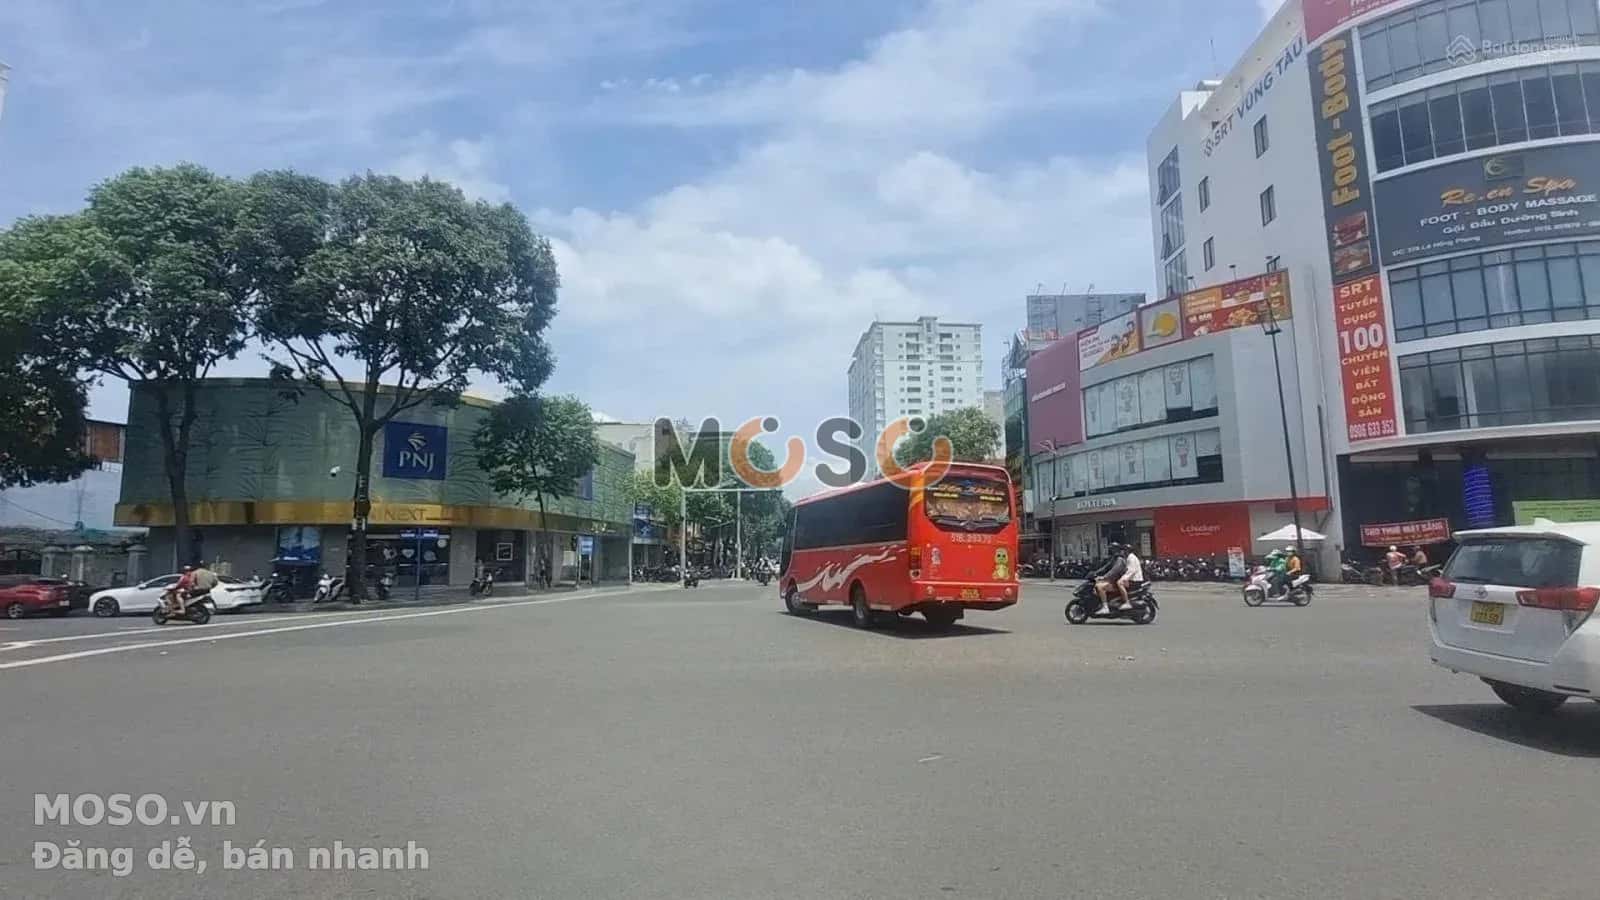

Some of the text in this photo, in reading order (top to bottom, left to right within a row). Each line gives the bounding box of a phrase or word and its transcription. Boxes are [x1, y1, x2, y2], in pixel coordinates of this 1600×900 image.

[1420, 212, 1459, 227] FOOT
[1477, 202, 1519, 216] BODY
[1525, 194, 1597, 208] MASSAGE
[1340, 279, 1374, 299] SRT
[1340, 323, 1384, 354] 100
[1352, 364, 1381, 377] VIÊN
[398, 450, 435, 473] PNJ
